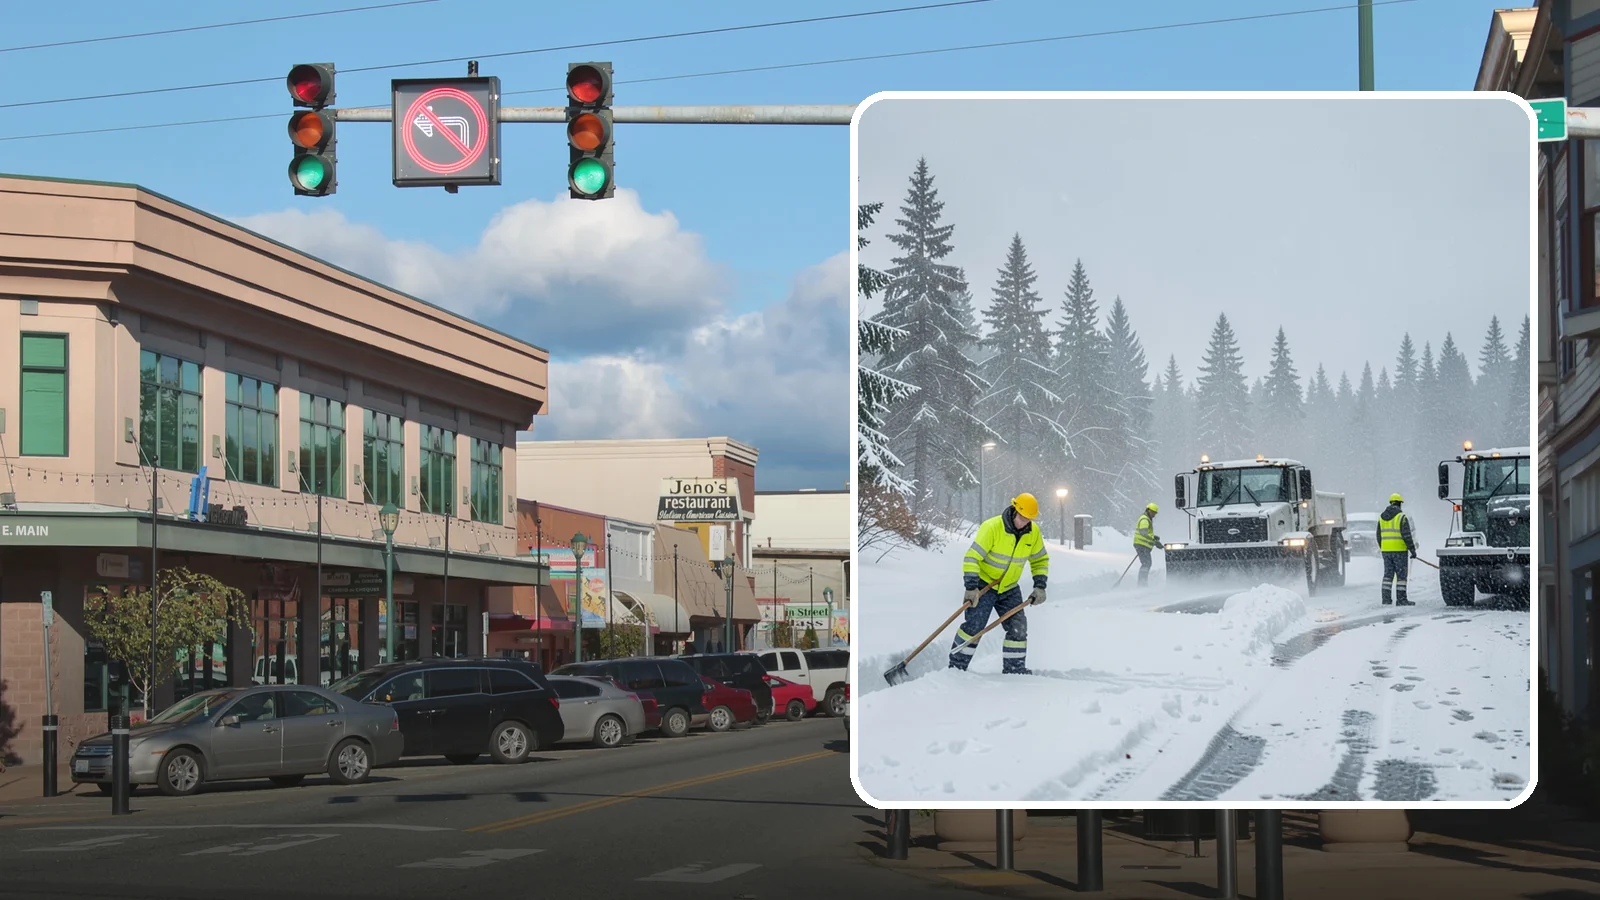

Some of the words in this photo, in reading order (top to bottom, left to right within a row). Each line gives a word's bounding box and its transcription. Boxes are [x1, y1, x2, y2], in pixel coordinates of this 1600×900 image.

[669, 480, 727, 495] Jeno's
[664, 496, 731, 509] restaurant
[686, 509, 715, 519] American
[715, 509, 737, 519] Cuisine
[2, 525, 13, 536] E.
[15, 525, 49, 536] MAIN
[785, 607, 795, 617] in
[797, 607, 828, 616] Street
[790, 619, 824, 627] lass
